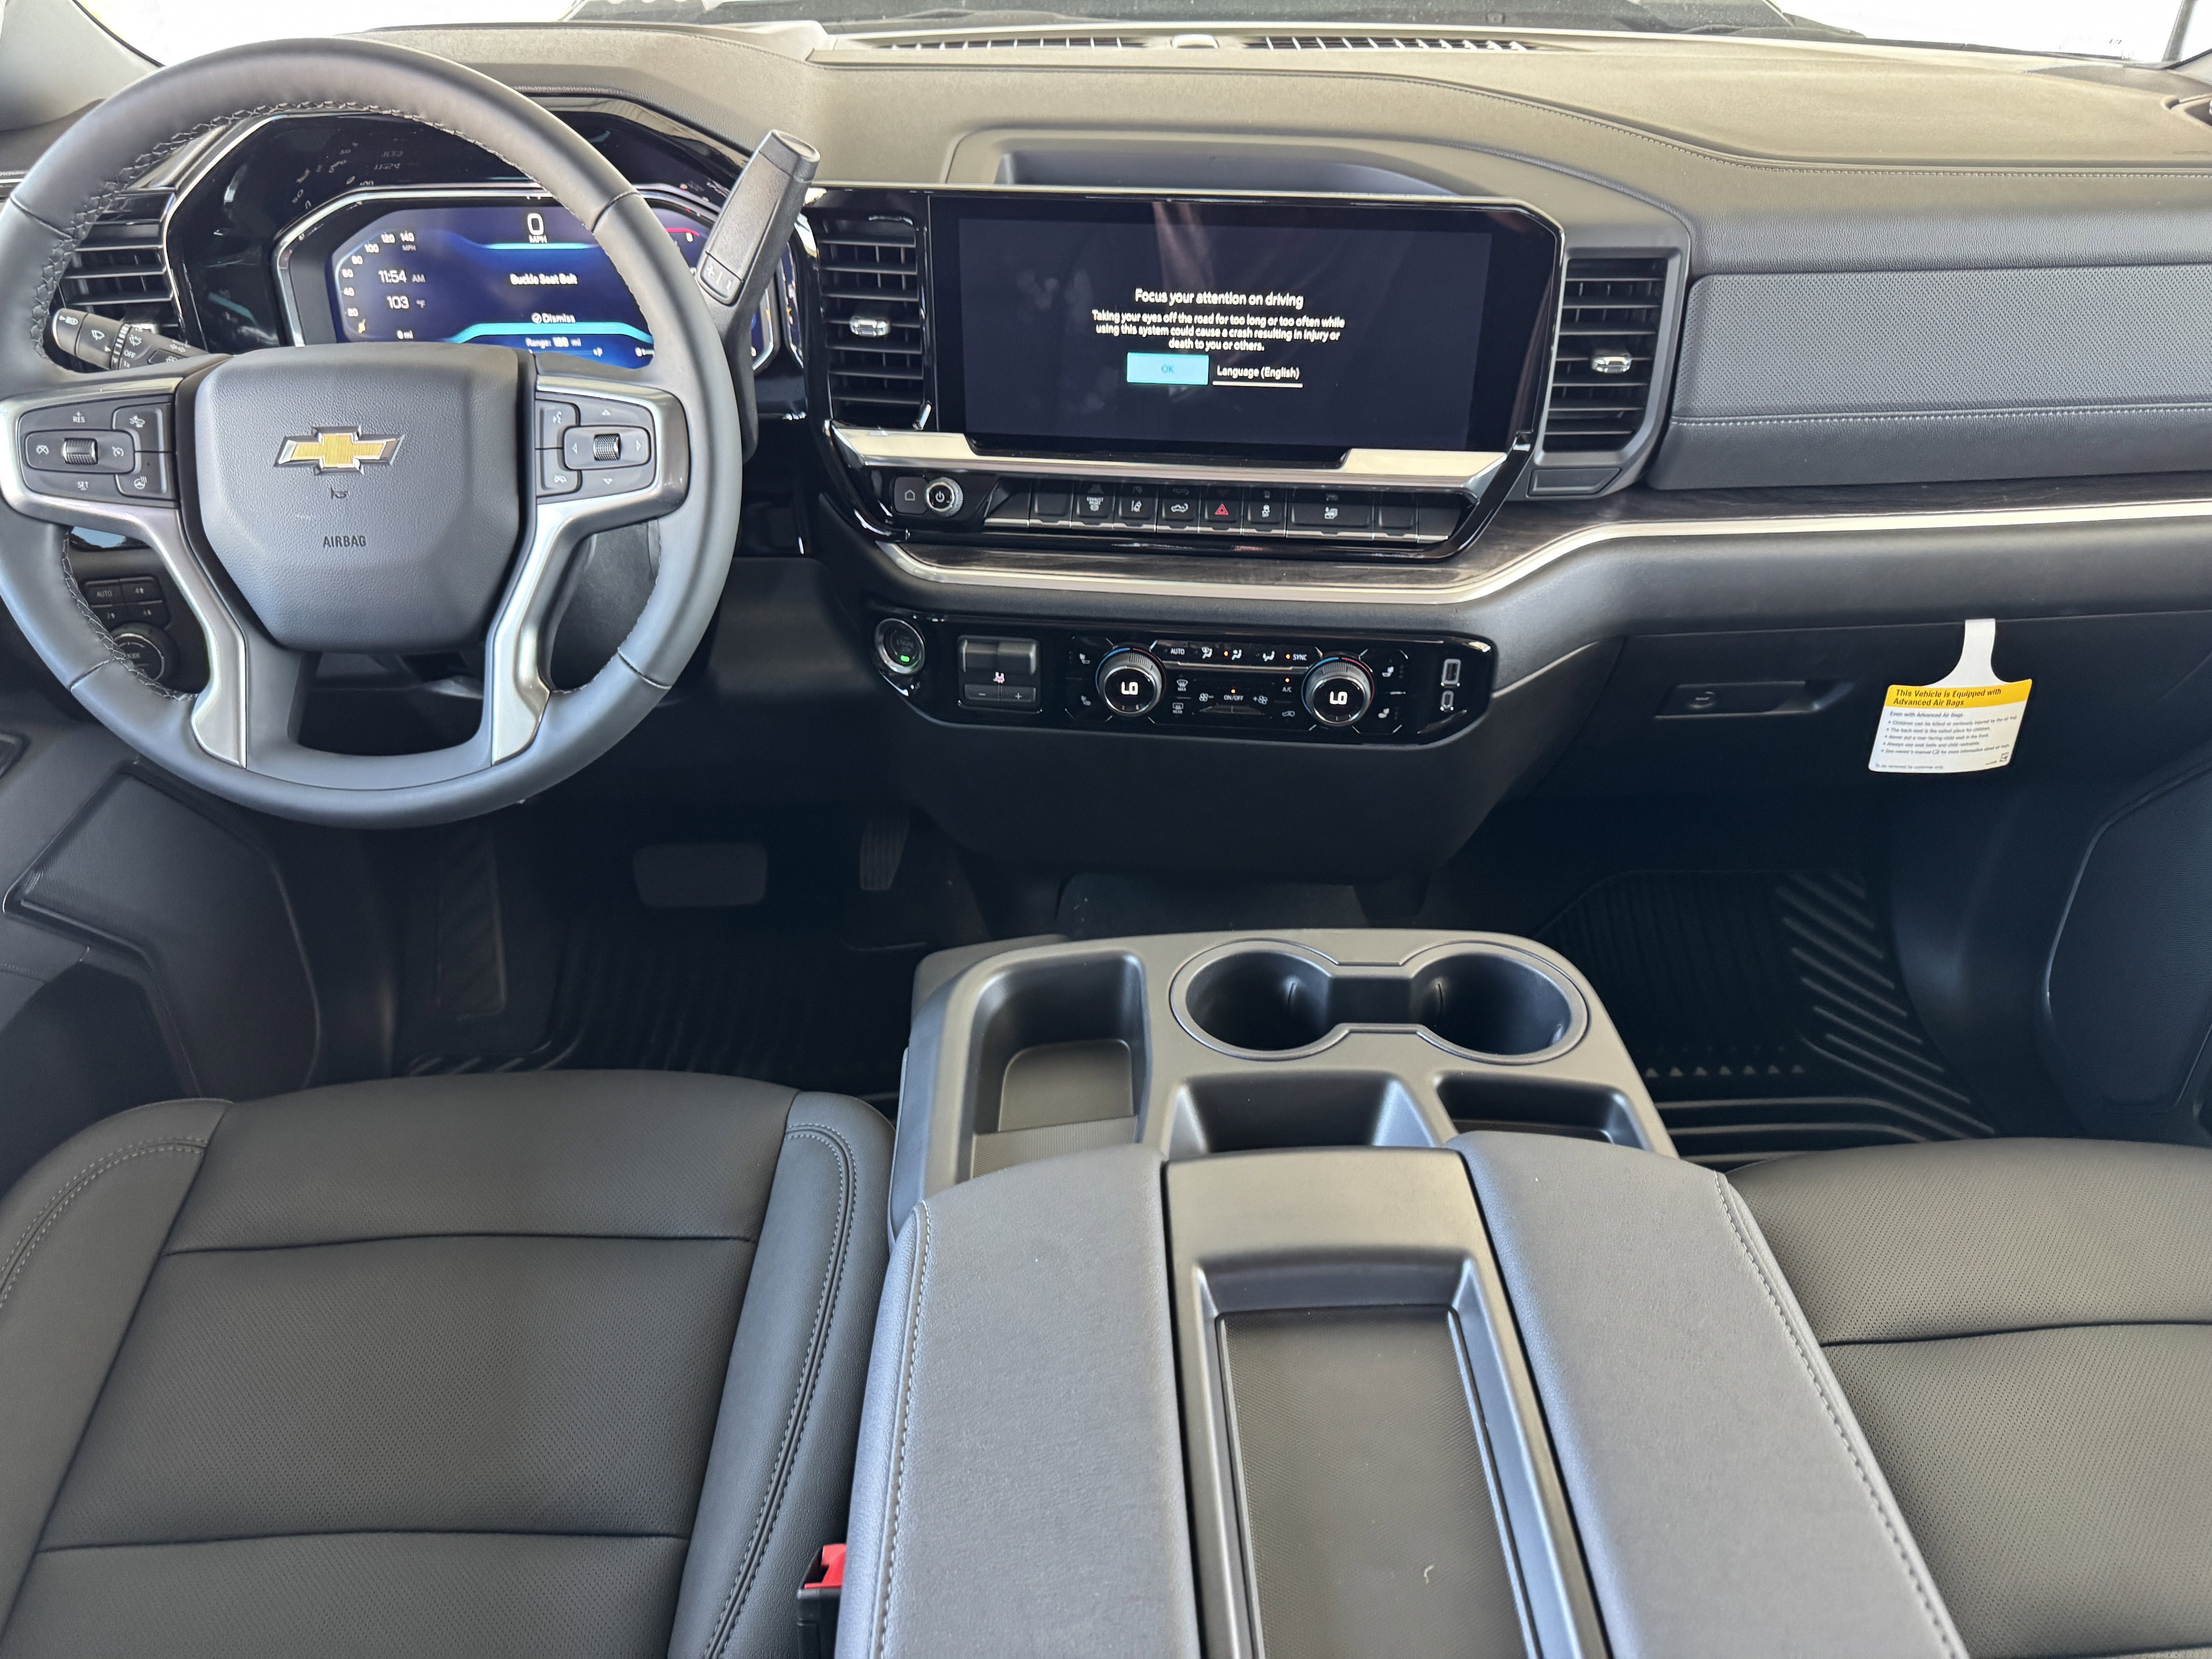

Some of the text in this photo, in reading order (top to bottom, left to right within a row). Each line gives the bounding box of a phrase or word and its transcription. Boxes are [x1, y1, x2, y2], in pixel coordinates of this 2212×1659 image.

[527, 213, 544, 235] 0
[381, 234, 395, 243] 120
[400, 232, 414, 242] 140
[529, 235, 547, 243] MPH
[364, 244, 379, 253] 100
[378, 270, 425, 283] 11:54 AM
[510, 273, 578, 285] Buckle Seat Belt
[343, 287, 354, 296] 40
[387, 296, 409, 309] 103
[1135, 288, 1304, 310] Focus your attention on driving
[542, 313, 576, 323] Dismiss
[1092, 309, 1345, 328] Taking your eyes off the road for too long or too often while
[1096, 323, 1340, 342] using this system could cause a crash resulting in injury or
[1168, 337, 1265, 352] death to you or others.
[1161, 364, 1173, 373] OK
[1217, 365, 1299, 380] Language (English)
[323, 534, 367, 548] AIRBAG
[1953, 689, 1985, 699] Equipped
